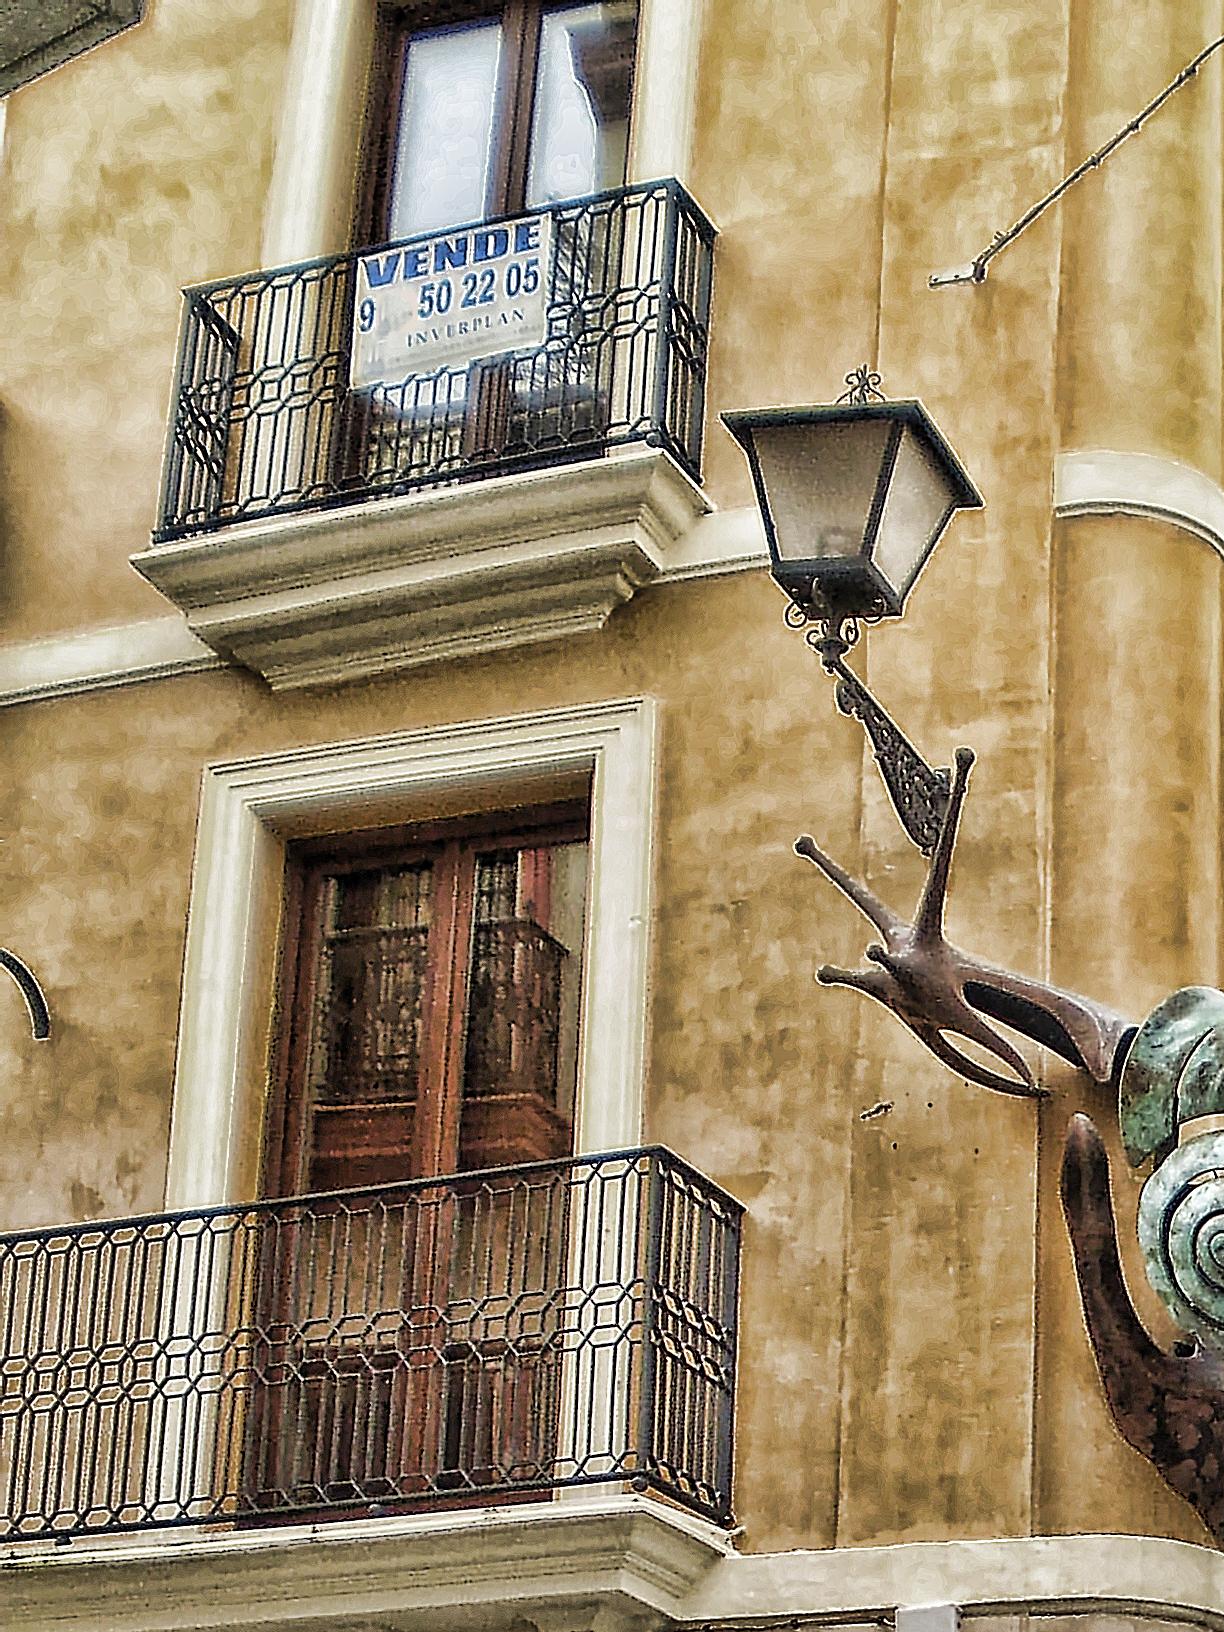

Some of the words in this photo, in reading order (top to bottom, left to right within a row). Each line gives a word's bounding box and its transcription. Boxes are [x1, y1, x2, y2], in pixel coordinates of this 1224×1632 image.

[362, 220, 542, 288] VENDE
[360, 298, 376, 332] 9
[418, 278, 452, 319] 50
[461, 268, 496, 308] 22
[506, 258, 540, 297] 05
